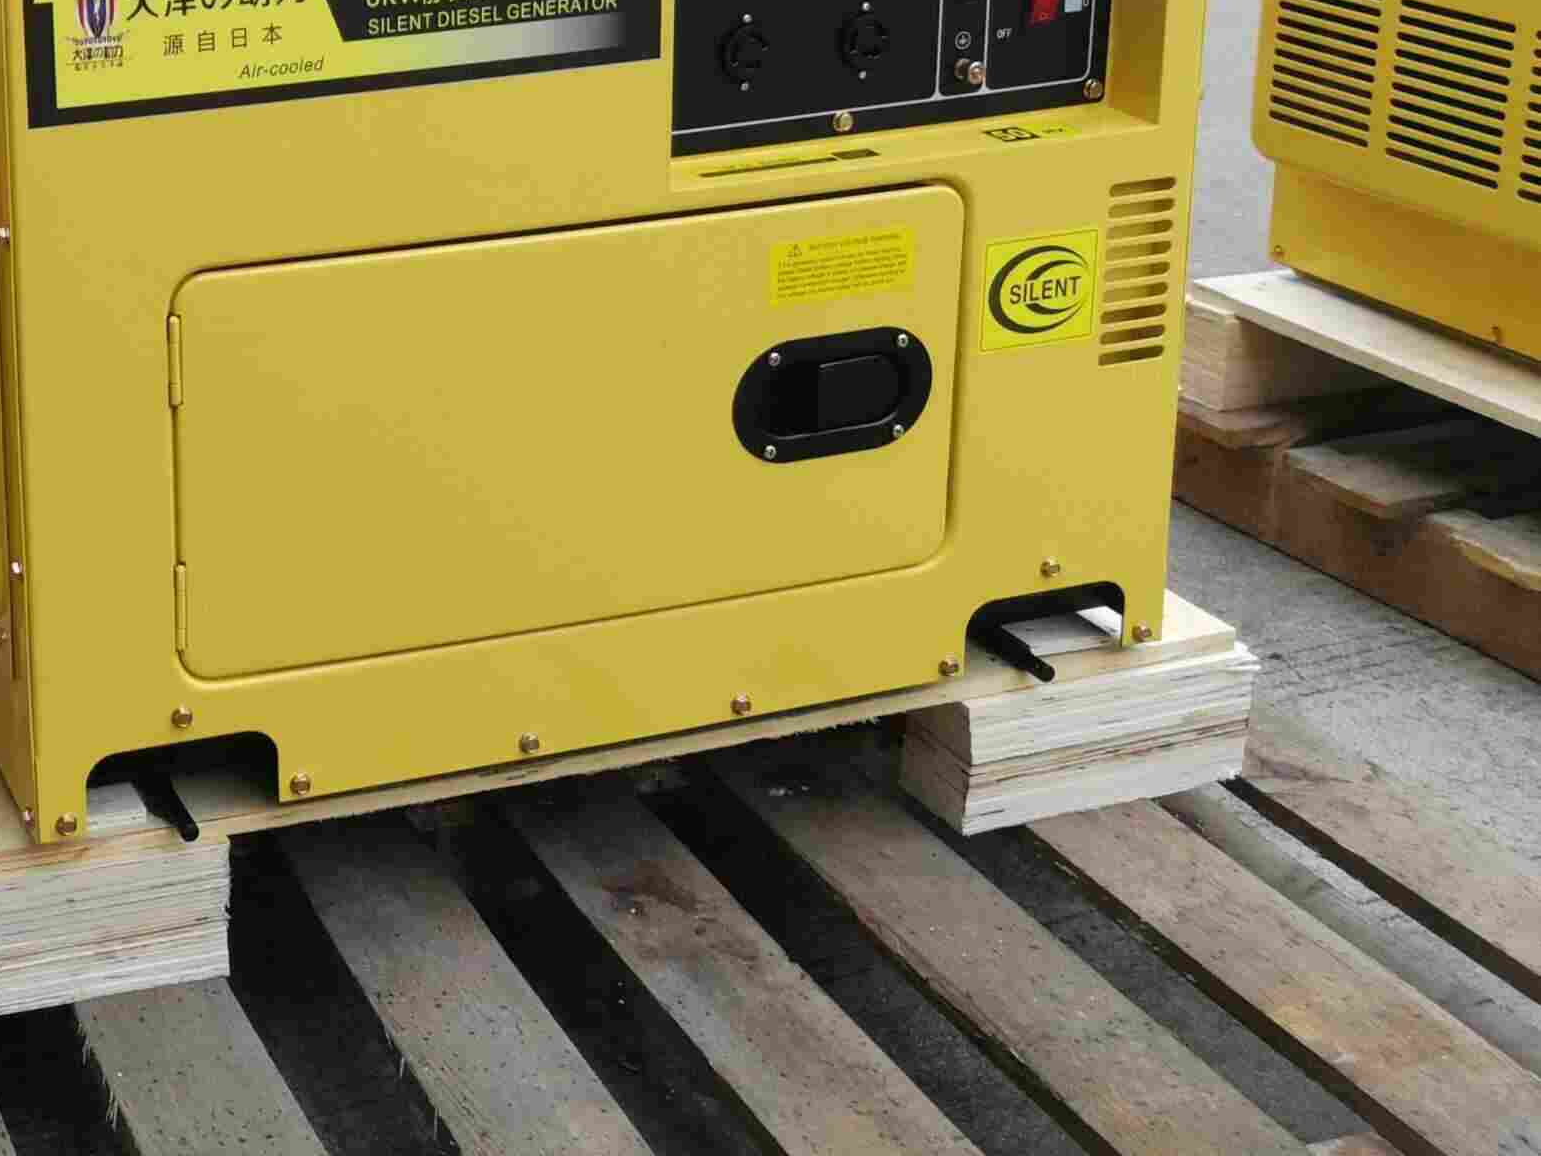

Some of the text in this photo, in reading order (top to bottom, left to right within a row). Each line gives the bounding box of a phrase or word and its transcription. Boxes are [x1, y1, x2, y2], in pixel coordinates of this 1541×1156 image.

[368, 11, 434, 36] SILENT
[437, 5, 503, 29] DIESEL
[996, 28, 1012, 39] OFF
[163, 21, 283, 57] 源自日本
[238, 55, 325, 80] Air-cooled
[1008, 274, 1083, 305] SILENT
